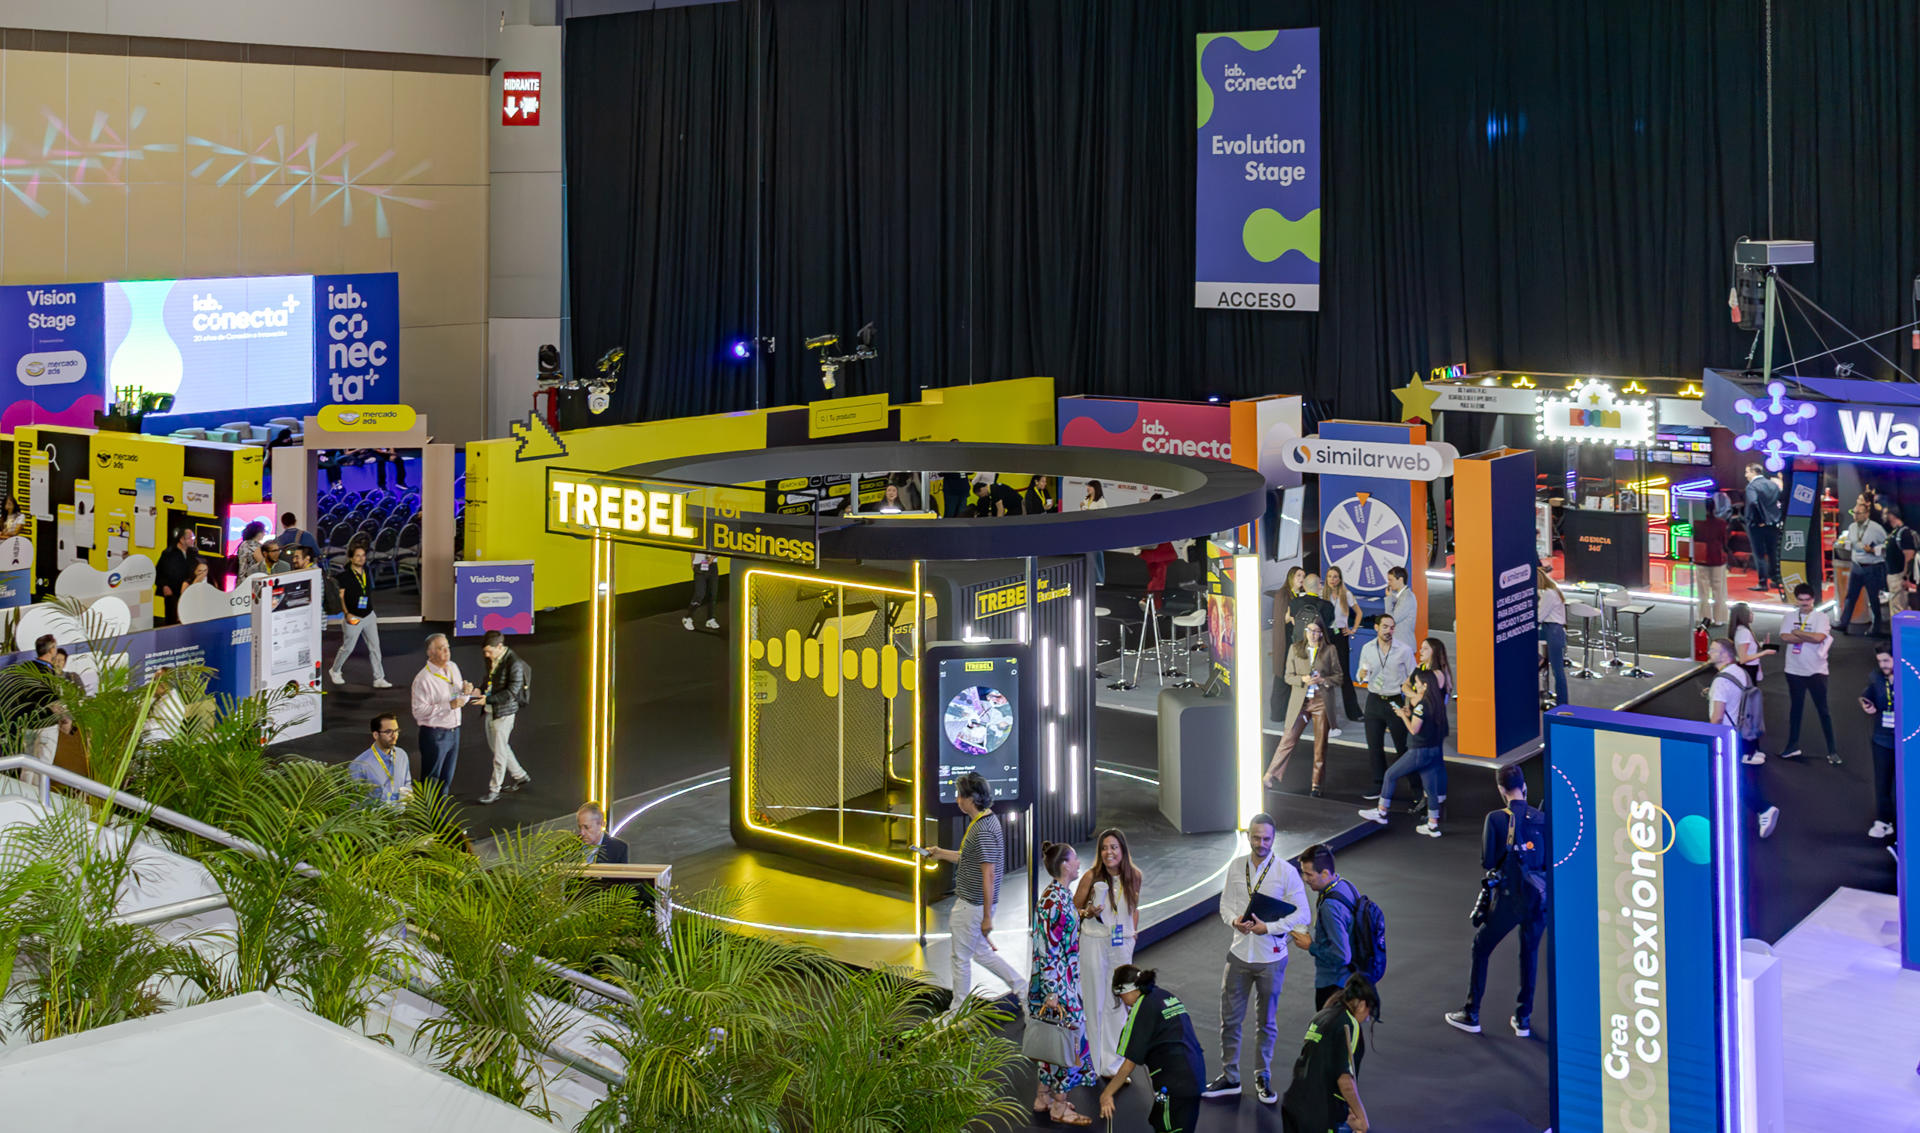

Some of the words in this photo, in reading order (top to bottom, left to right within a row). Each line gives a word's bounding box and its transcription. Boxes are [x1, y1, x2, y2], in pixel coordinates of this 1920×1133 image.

[1224, 63, 1246, 77] iab.
[504, 78, 540, 90] HIDRANTE
[1212, 133, 1306, 155] Evolution
[1244, 160, 1306, 186] Stage
[27, 289, 76, 306] Vision
[192, 293, 223, 311] iab.
[327, 284, 368, 311] iab.
[1217, 291, 1296, 308] ACCESO
[28, 313, 76, 331] Stage
[47, 368, 61, 376] ads
[48, 359, 78, 368] mercado
[362, 411, 398, 419] mercado
[362, 418, 377, 426] ads
[1142, 418, 1170, 436] iab.
[1316, 445, 1431, 472] similarweb
[553, 481, 699, 539] TREBEL
[714, 488, 741, 519] for
[713, 523, 815, 561] Business
[1578, 535, 1612, 545] AGENCIA
[469, 575, 495, 583] Vision
[495, 575, 520, 584] Stage
[1037, 578, 1049, 590] for
[462, 620, 477, 629] iab.
[1620, 800, 1662, 1064] conexiones
[1603, 1013, 1631, 1080] Crea
